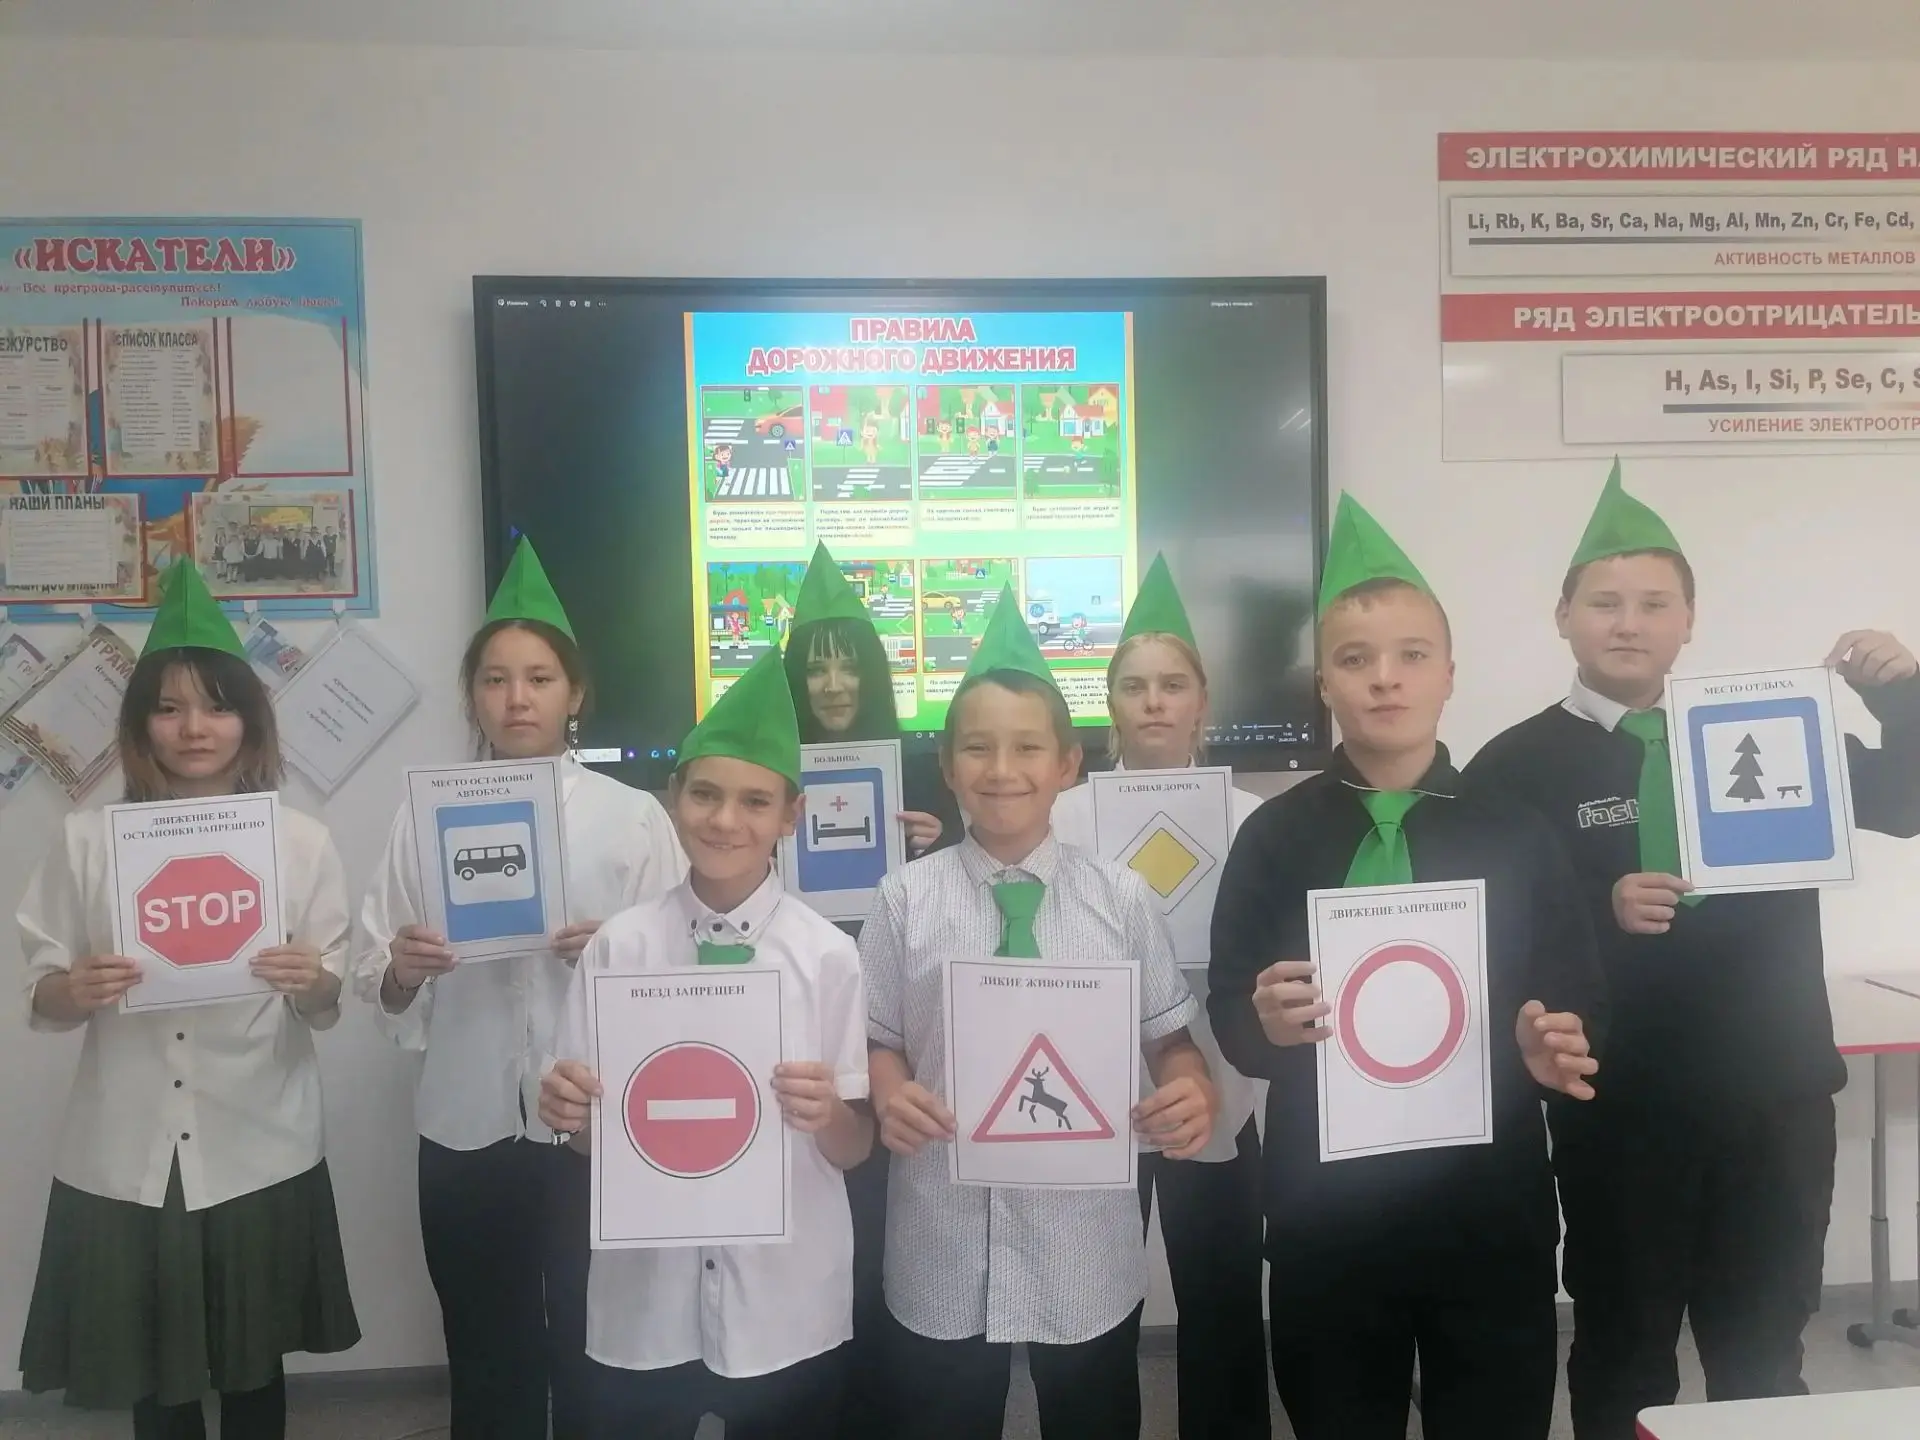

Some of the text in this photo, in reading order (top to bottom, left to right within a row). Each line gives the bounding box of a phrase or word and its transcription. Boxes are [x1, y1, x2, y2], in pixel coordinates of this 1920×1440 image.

[1465, 143, 1920, 172] ЭЛЕКТРОХИМИЧЕСКИЙ РЯД Н
[1468, 211, 1915, 232] Li, Rb, K, Ba, Sr, Ca, Na, Mg, Al, Mn, Zn, Cr, Fe, Cd,
[14, 237, 297, 274] «ИСКАТЕЛИ»
[1714, 250, 1916, 266] АКТИВНОСТЬ МЕТАЛЛОВ
[1514, 303, 1920, 331] РЯД ЭЛЕКТРООТРИЦАТЕЛЬ
[850, 317, 977, 342] ПРАВИЛА
[117, 331, 198, 347] СПИСОК КЛАССА
[746, 346, 1077, 375] ДОРОЖНОГО ДВИЖЕНИЯ
[1665, 369, 1691, 395] H,
[1699, 369, 1738, 394] As,
[1769, 368, 1800, 393] Si,
[1808, 368, 1827, 393] P,
[1835, 368, 1872, 394] Se,
[1881, 367, 1905, 394] C,
[1709, 416, 1920, 433] УСИЛЕНИЕ ЭЛЕКТРООТР
[10, 496, 105, 510] НАШИ ПЛАНЫ
[1704, 680, 1794, 695] МЕСТО ОТДЫХА
[814, 755, 861, 764] БОЛЬНИЦА
[432, 774, 534, 788] МЕСТО ОСТАНОВКИ
[1119, 783, 1200, 793] ГЛАВНАЯ ДОРОГА
[456, 788, 511, 799] АВТОБУСА
[151, 810, 238, 826] ДВИЖЕНИЕ БЕЗ
[123, 821, 265, 841] ОСТАНОВКИ ЗАПРЕЩЕНО
[144, 889, 256, 933] STOP
[1329, 900, 1467, 921] ДВИЖЕНИЕ ЗАПРЕЩЕНО
[979, 975, 1101, 989] ДИКИЕ ЖИВОТНЫЕ
[631, 985, 745, 999] ВЪЕЗД ЗАПРЕЩЕН
